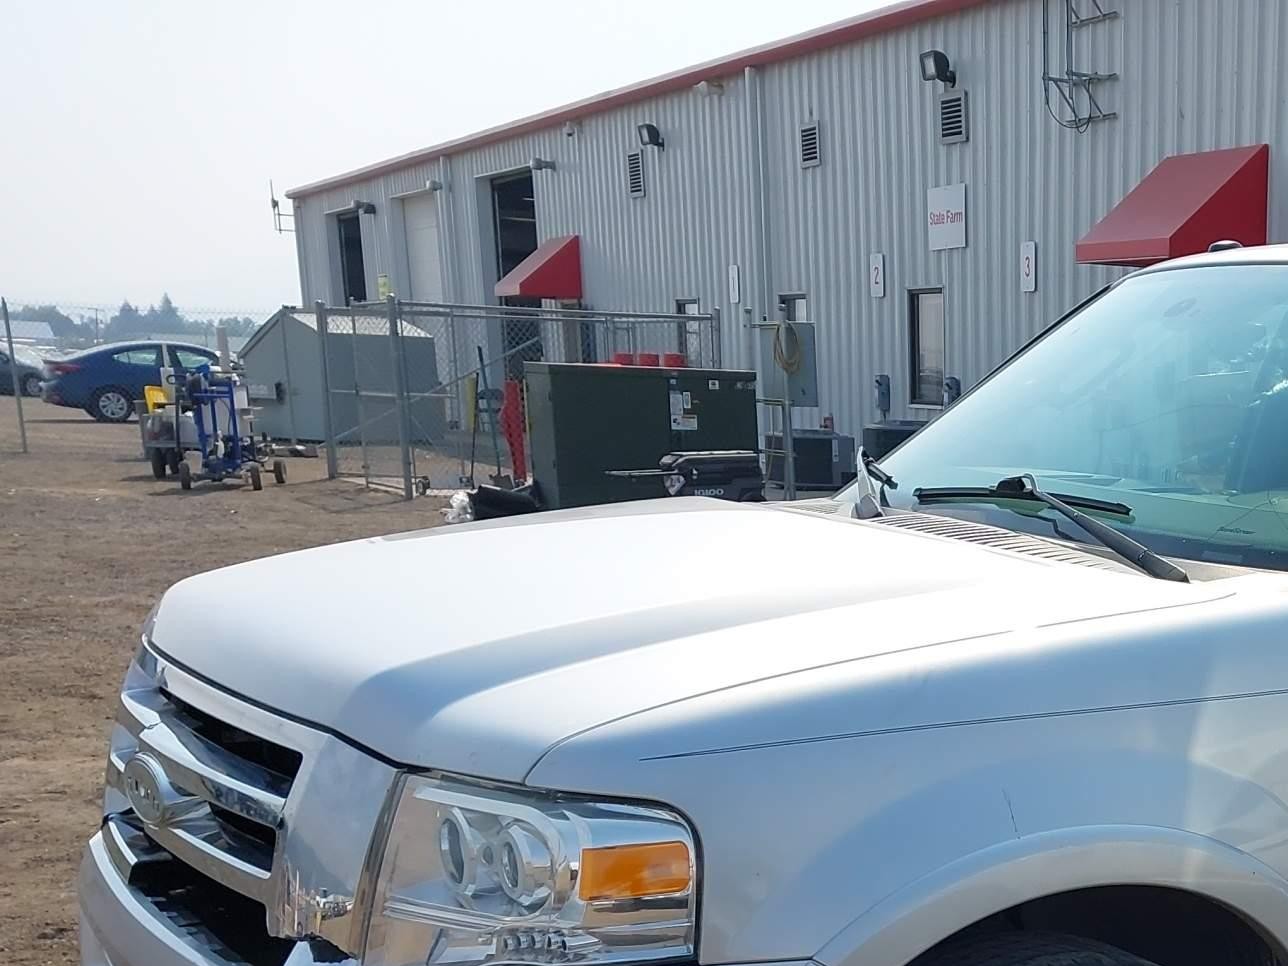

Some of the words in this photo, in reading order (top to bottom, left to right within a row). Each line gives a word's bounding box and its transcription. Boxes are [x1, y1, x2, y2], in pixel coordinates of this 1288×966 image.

[929, 212, 945, 225] State
[946, 210, 963, 223] Farm
[873, 266, 880, 285] 2
[1024, 255, 1031, 277] 3
